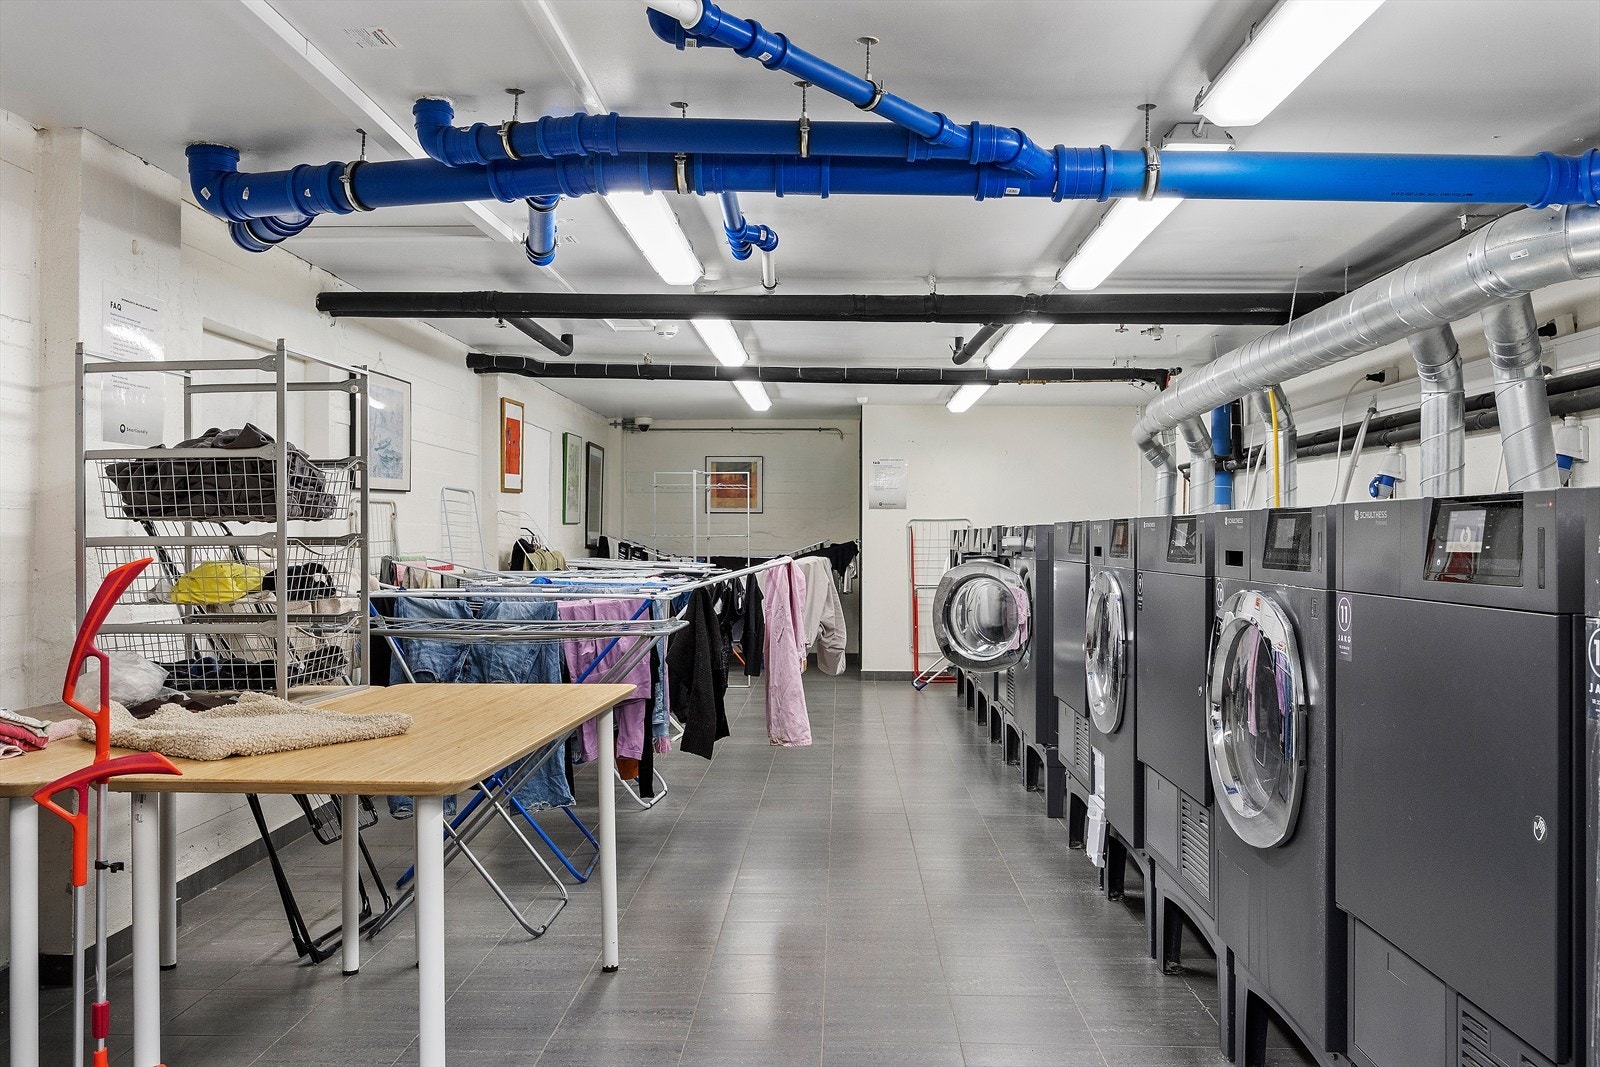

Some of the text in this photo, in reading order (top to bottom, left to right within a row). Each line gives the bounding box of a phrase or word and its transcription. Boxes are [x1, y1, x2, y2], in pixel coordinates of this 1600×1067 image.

[110, 301, 122, 311] FAQ
[1359, 510, 1387, 519] SCHULTHESS
[1340, 605, 1348, 624] 11
